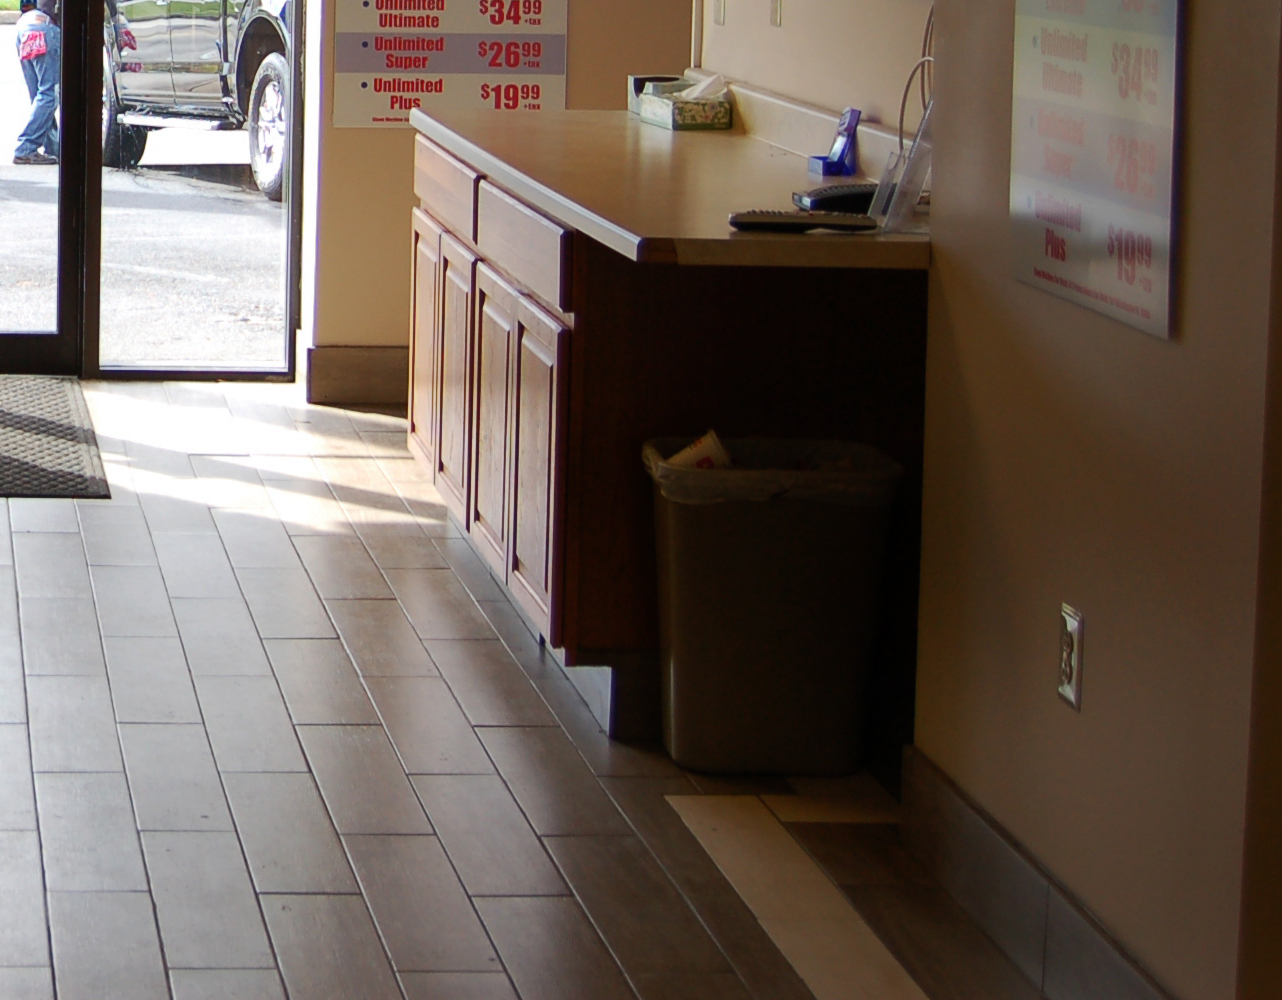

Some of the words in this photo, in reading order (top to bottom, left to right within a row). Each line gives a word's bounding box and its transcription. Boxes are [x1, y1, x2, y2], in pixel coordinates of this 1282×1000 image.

[379, 13, 440, 28] Ultimate
[374, 37, 445, 52] Unlimited
[1041, 26, 1088, 62] Unlimited
[385, 53, 428, 70] Super
[373, 78, 443, 93] Unlimited
[390, 95, 421, 110] Plus
[1035, 191, 1081, 232] Unlimited
[1045, 228, 1066, 262] Plus
